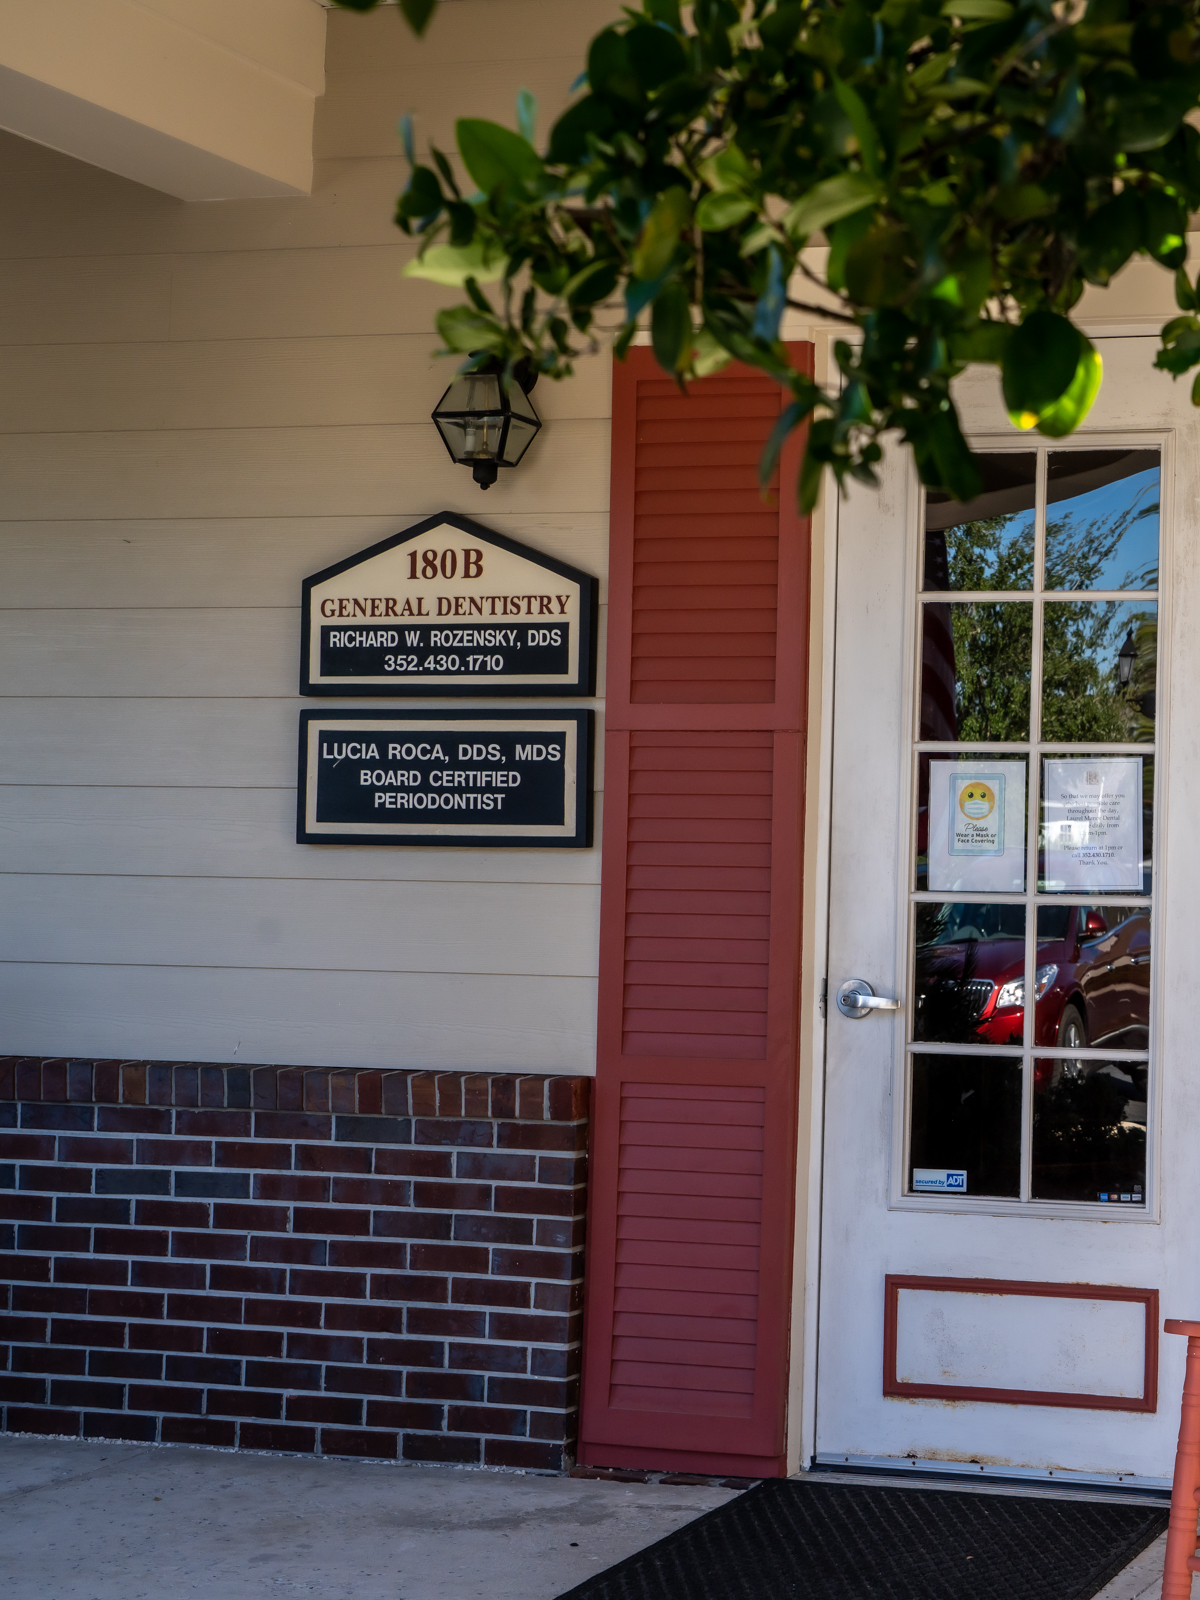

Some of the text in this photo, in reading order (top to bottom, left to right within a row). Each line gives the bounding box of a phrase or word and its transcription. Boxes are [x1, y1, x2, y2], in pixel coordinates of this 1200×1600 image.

[320, 594, 571, 618] GENERAL DENTISTRY
[329, 629, 562, 649] RICHARD W. ROZENSKY, DDS
[384, 655, 504, 671] 352.430.1710
[322, 743, 561, 763] LUCIA ROCA, DDS, MDS
[360, 770, 521, 787] BOARD CERTIFIED
[375, 793, 505, 810] PERIODONTIST
[964, 822, 989, 832] Please
[946, 1175, 965, 1186] ADT
